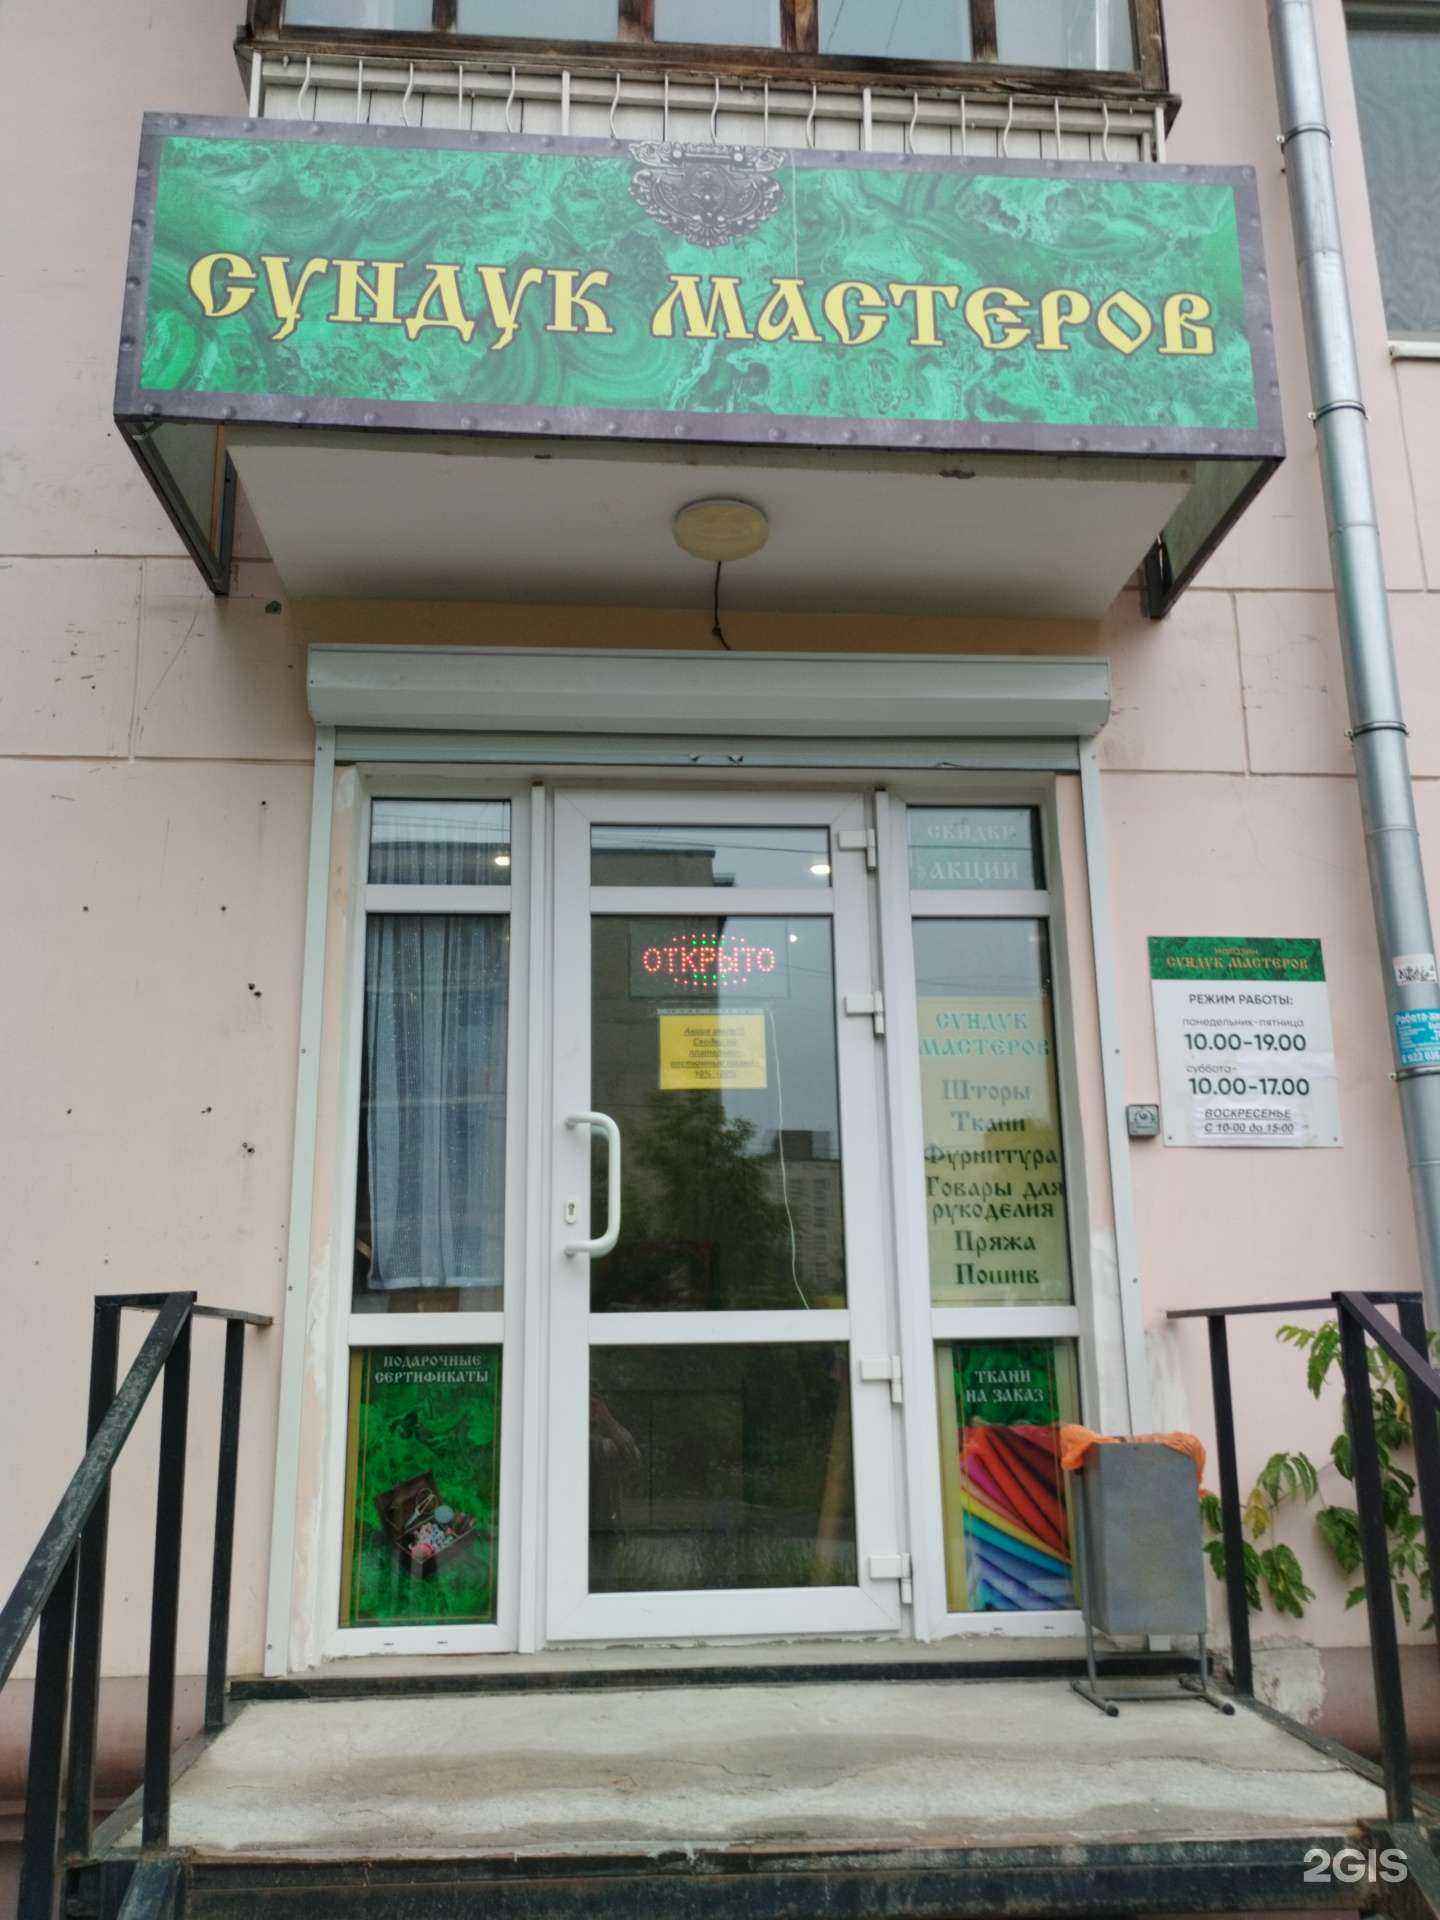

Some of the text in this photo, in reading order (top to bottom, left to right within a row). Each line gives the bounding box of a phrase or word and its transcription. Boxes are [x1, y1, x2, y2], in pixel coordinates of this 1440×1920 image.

[188, 250, 1216, 356] СУНДУК МАСТЕРОВ
[930, 861, 1018, 883] АКЦИИ
[643, 947, 775, 972] ОТКРЫТО
[1166, 957, 1309, 969] СУНДУК МАСТЕРОВ
[1189, 994, 1294, 1005] РЕЖИМ РАБОТЫ:
[936, 1012, 1027, 1031] СУНДУК
[919, 1039, 1049, 1056] МАСТЕРОВ
[1184, 1033, 1307, 1051] 10.00-19.00
[943, 1079, 1031, 1105] Шторы
[1188, 1078, 1310, 1096] 10.00-17.00
[950, 1110, 1026, 1132] Ткани
[1204, 1108, 1292, 1119] ВОСКРЕСЕНЬЕ
[924, 1144, 1058, 1171] Фурнитура
[1022, 1182, 1064, 1200] для
[933, 1204, 1055, 1225] рукоделия
[955, 1230, 1036, 1258] Пряжа
[956, 1263, 1039, 1285] Пошив
[384, 1356, 481, 1368] ПОДАРОЧНЫЕ
[375, 1371, 488, 1383] СЕРТИФИКАТЫ
[975, 1370, 1031, 1383] ТКАНИ
[966, 1389, 1044, 1402] НА ЗАКАЗ
